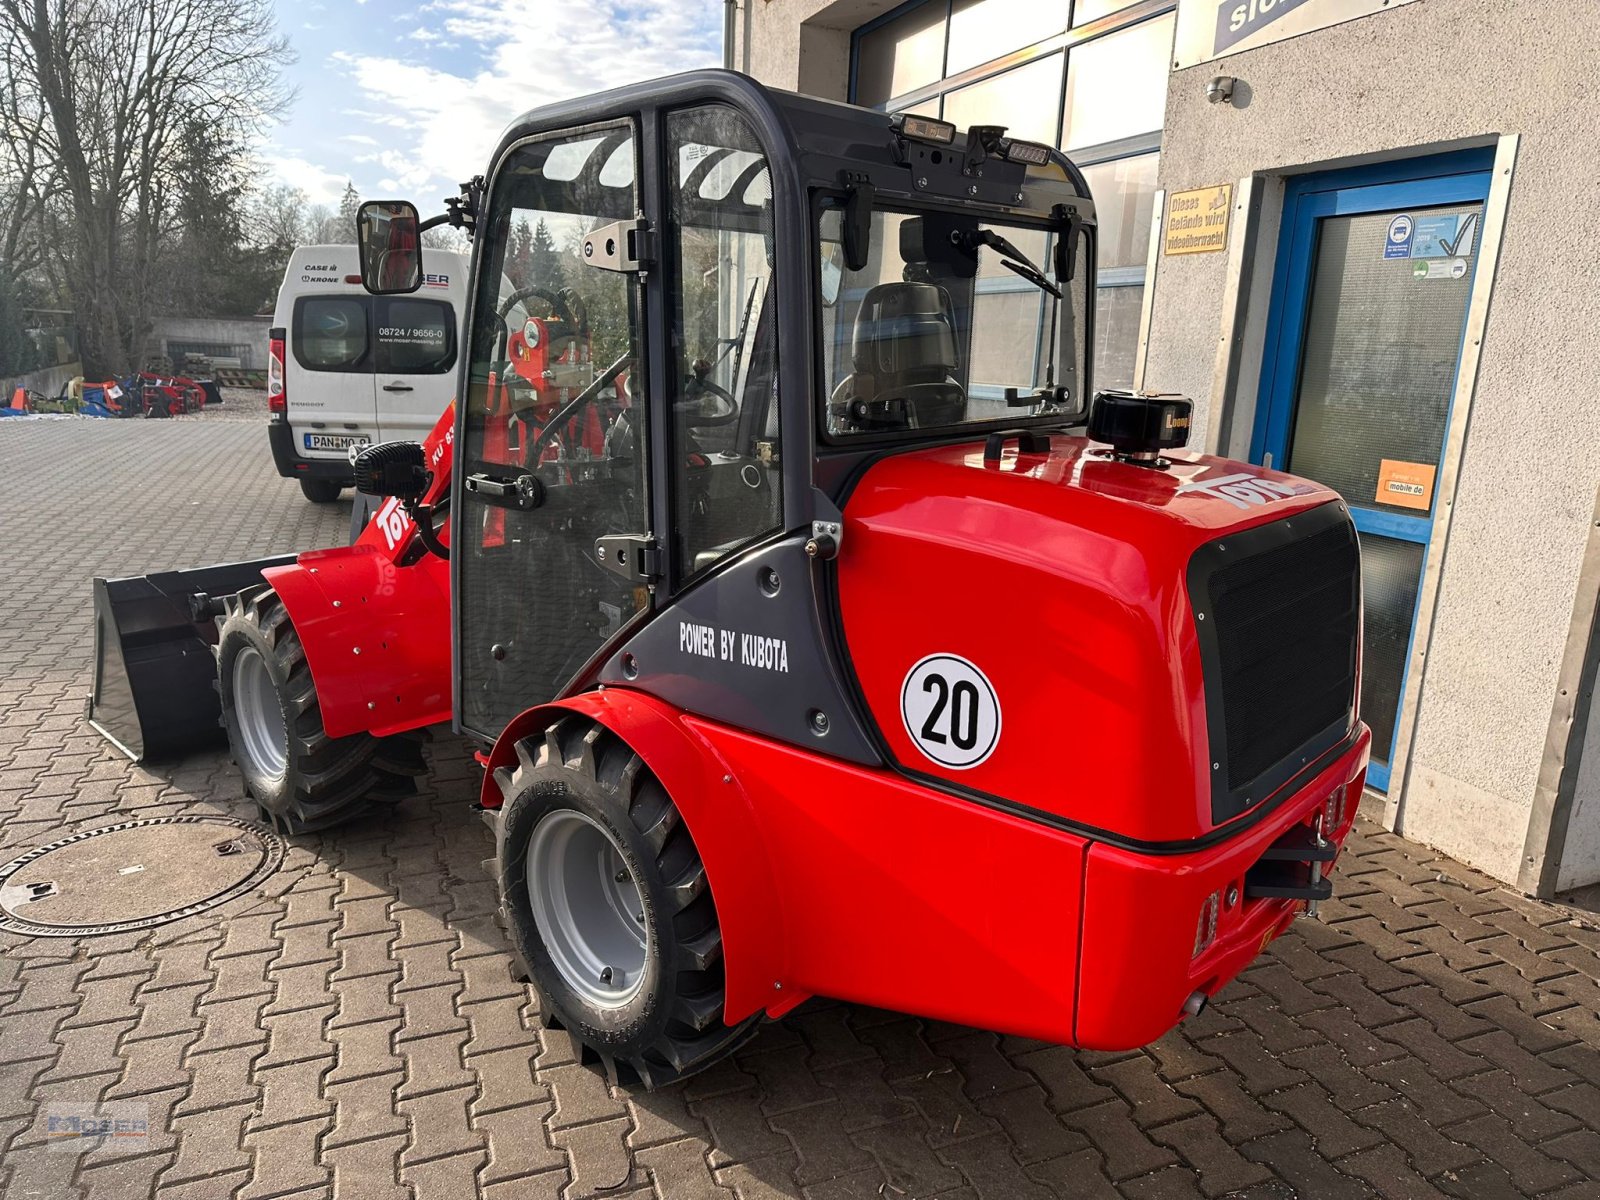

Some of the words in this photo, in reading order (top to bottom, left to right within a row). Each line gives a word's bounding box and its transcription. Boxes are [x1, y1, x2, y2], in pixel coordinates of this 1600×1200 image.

[1171, 198, 1200, 213] Dieses
[1169, 214, 1203, 231] Gelände
[1205, 210, 1226, 227] wird
[1167, 231, 1224, 250] videoüberwacht
[379, 327, 405, 336] 08724
[412, 328, 443, 338] 9656-0
[313, 436, 334, 447] PAN
[432, 443, 443, 466] KU
[1176, 473, 1297, 510] TOYO
[680, 621, 716, 659] POWER
[720, 629, 736, 662] BY
[741, 633, 789, 673] KUBOTA
[921, 673, 979, 751] 20
